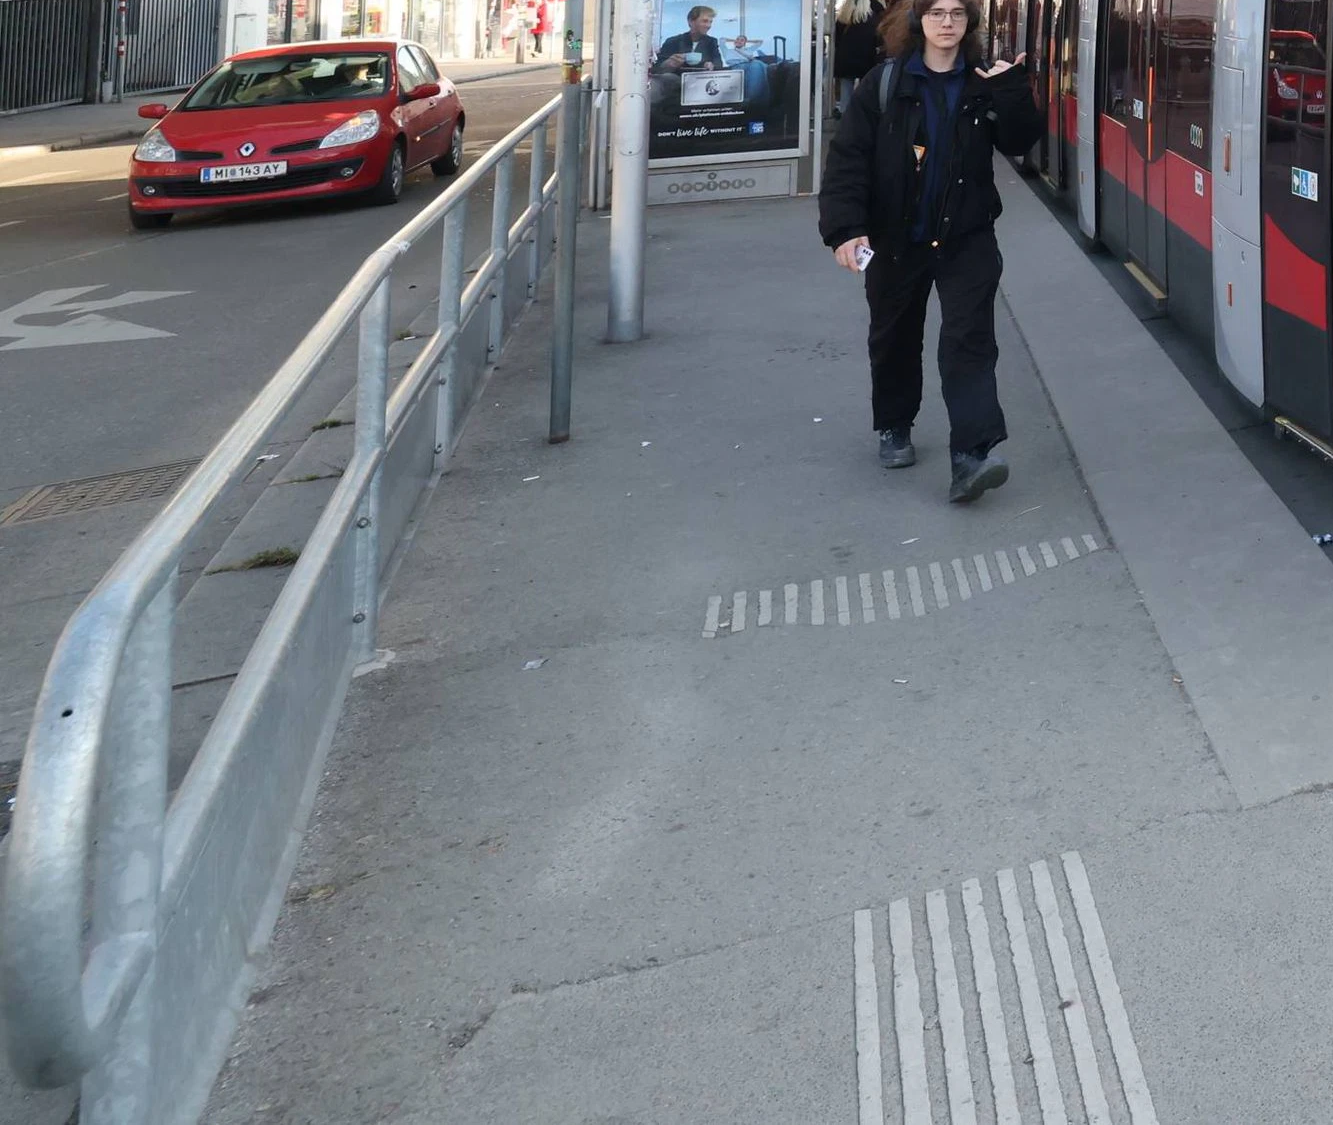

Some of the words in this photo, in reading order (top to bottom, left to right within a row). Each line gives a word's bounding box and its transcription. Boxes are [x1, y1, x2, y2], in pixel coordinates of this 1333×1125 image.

[694, 126, 709, 137] life
[215, 168, 228, 179] MI
[239, 165, 260, 176] 143
[263, 164, 280, 174] AY
